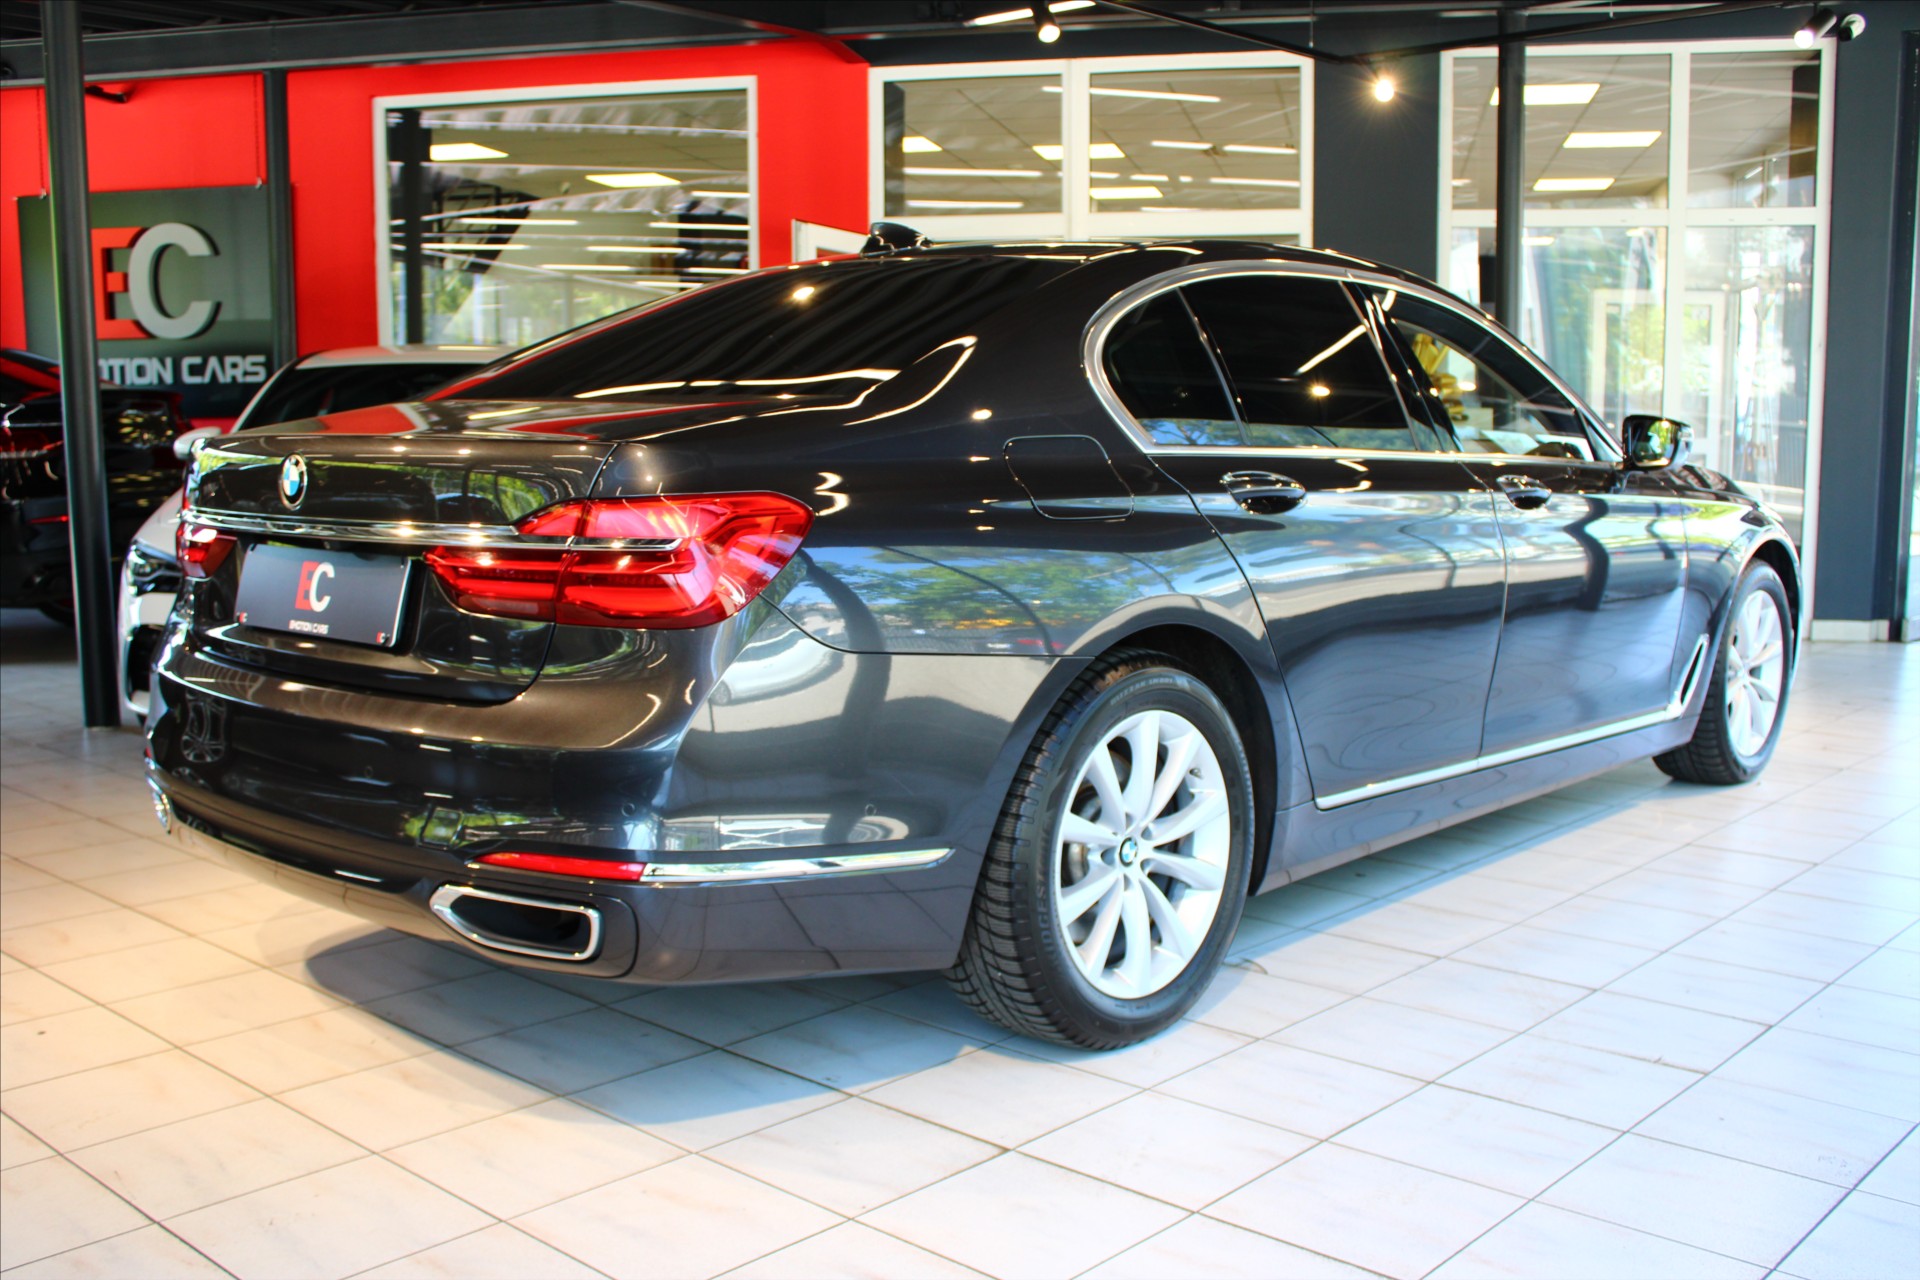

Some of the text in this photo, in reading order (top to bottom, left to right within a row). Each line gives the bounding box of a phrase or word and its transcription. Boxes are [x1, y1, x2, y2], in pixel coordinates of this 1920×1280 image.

[91, 222, 218, 340] EC
[181, 355, 267, 384] CARS
[294, 560, 336, 613] EC
